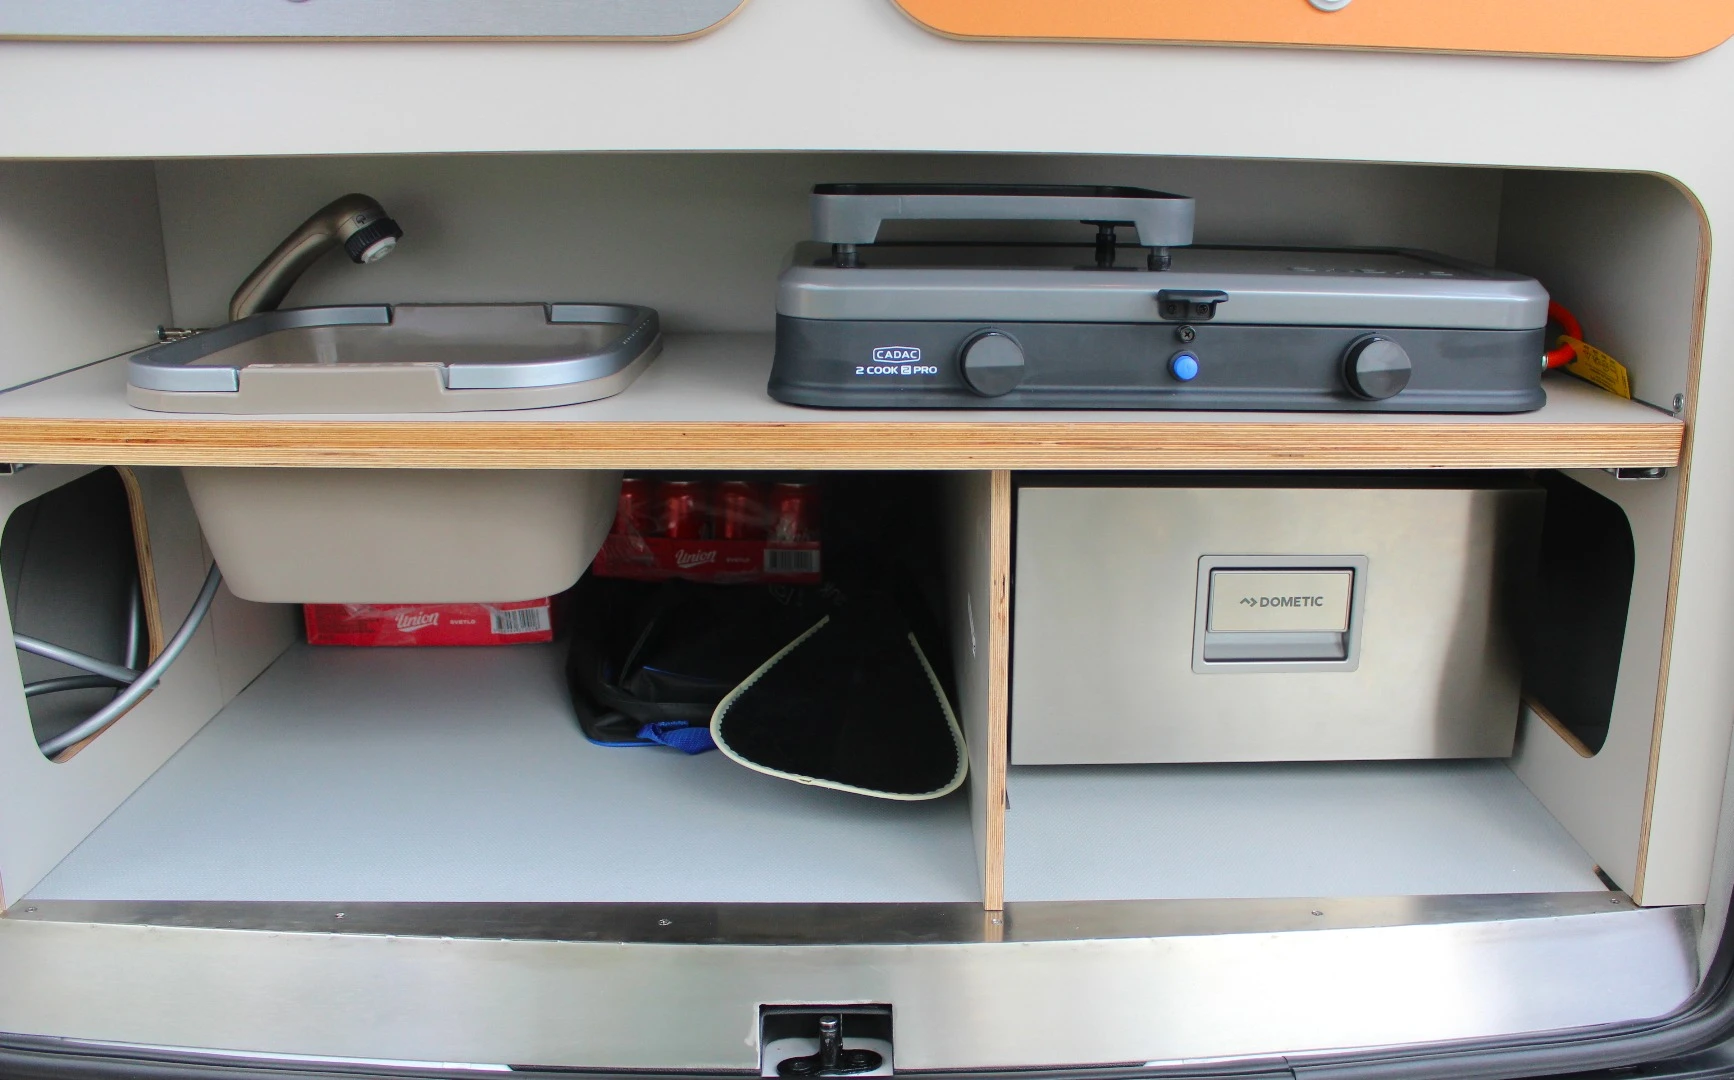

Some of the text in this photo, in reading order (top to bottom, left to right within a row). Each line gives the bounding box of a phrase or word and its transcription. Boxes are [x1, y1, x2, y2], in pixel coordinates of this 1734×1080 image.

[876, 350, 918, 359] CADAC
[855, 365, 938, 375] 2 COOK 2 PRO
[675, 549, 717, 568] Union
[1259, 596, 1324, 608] DOMETIC
[395, 612, 439, 632] Union
